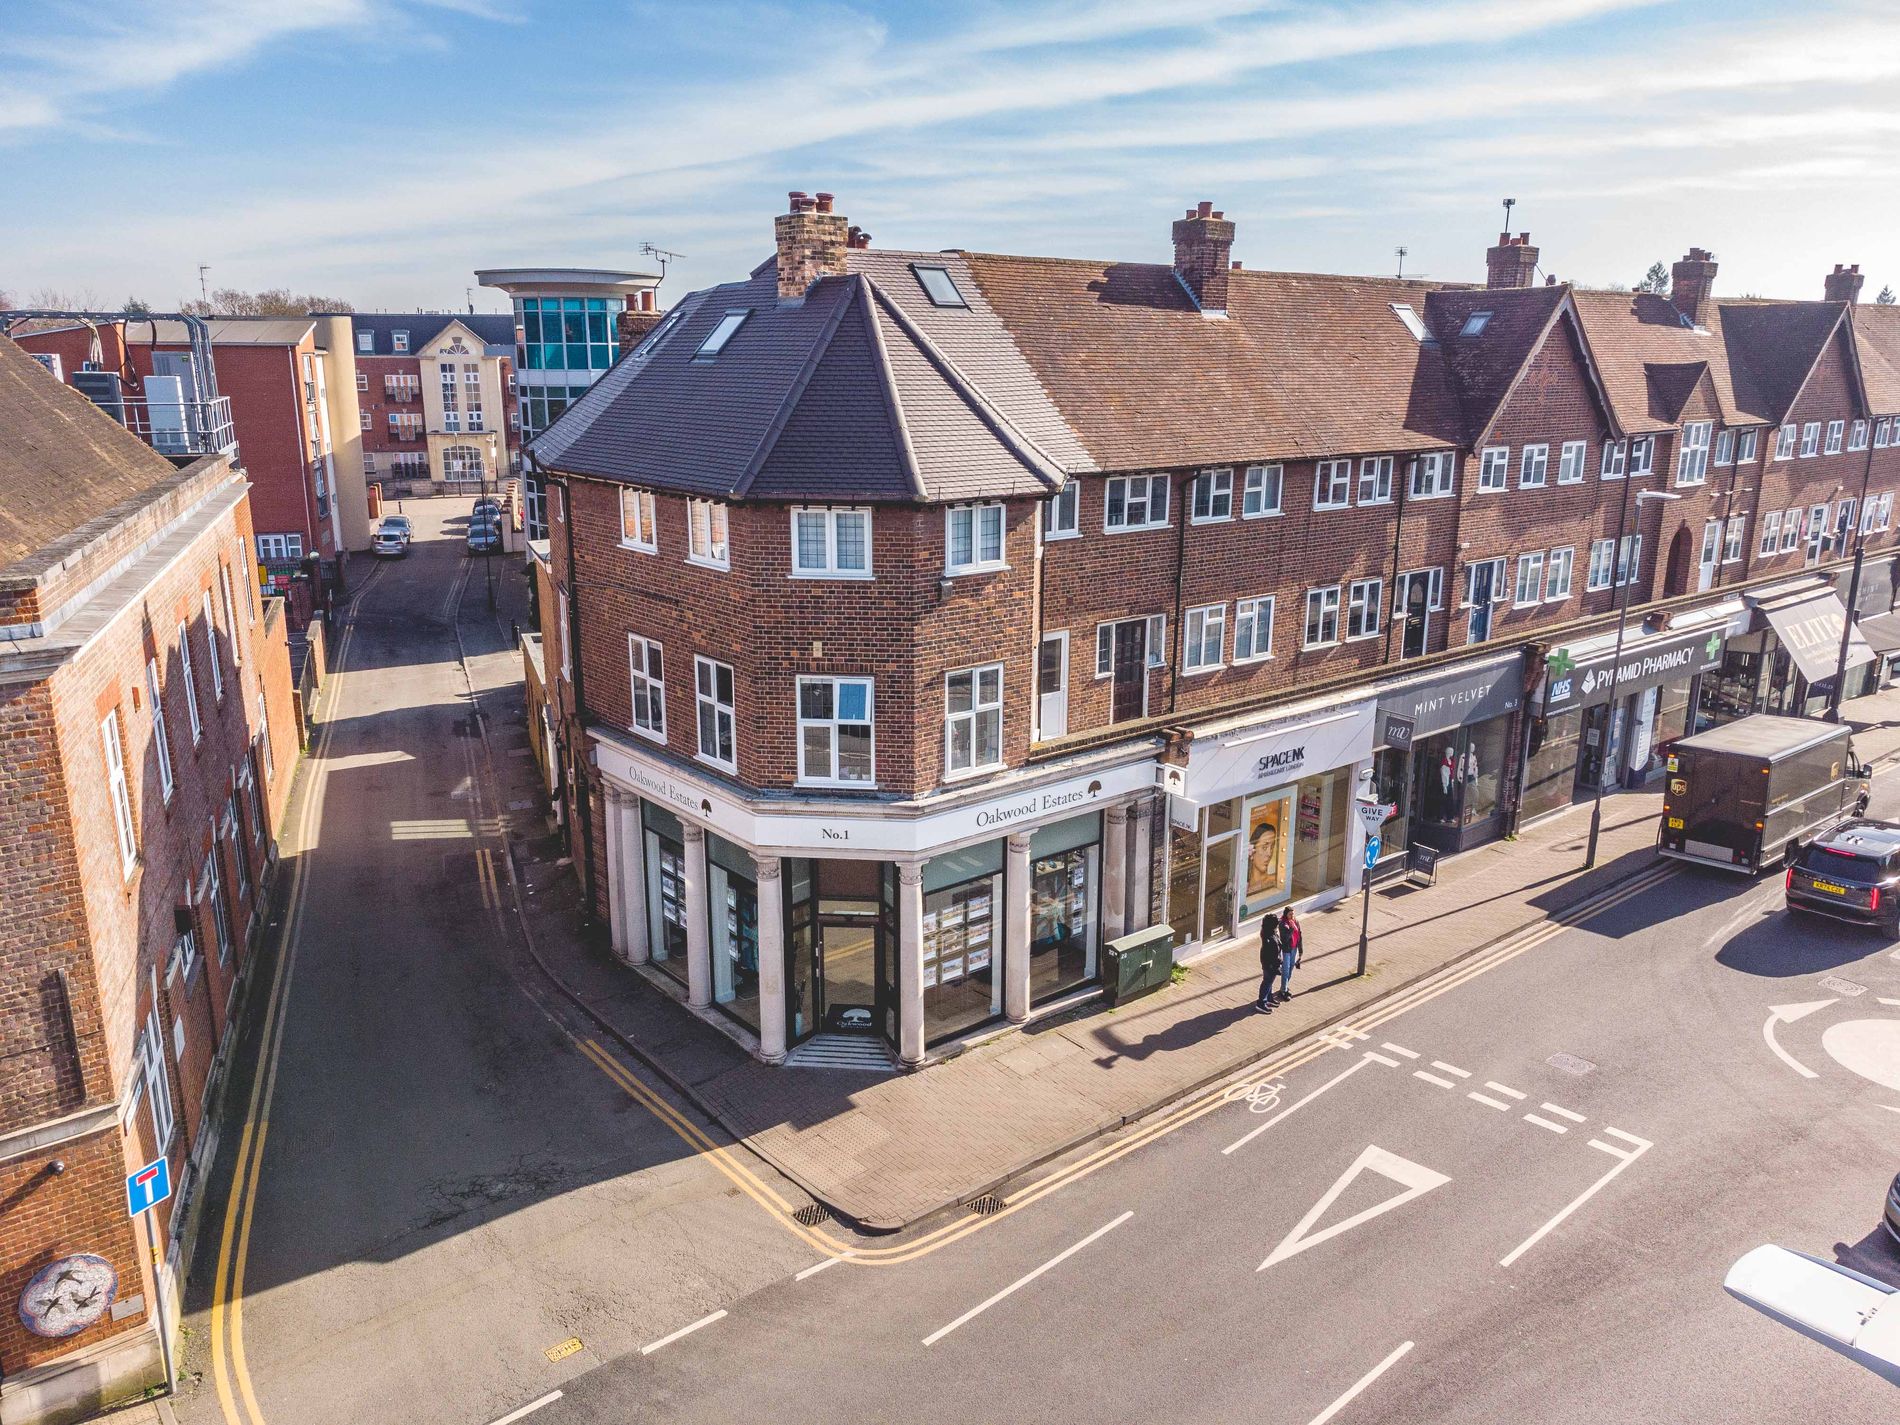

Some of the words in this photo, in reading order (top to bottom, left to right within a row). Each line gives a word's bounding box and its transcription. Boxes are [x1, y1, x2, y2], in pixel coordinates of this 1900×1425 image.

[1643, 647, 1695, 676] PHARMACY
[1552, 679, 1571, 697] NHS
[1414, 697, 1445, 716] MINT
[1450, 685, 1492, 705] VELVET
[629, 766, 666, 795] Oakwood
[669, 784, 699, 810] Estates
[1672, 782, 1686, 793] ups
[976, 798, 1037, 827] Oakwood
[1042, 791, 1083, 810] Estates
[1361, 806, 1383, 816] GIVE
[822, 828, 849, 840] No.1
